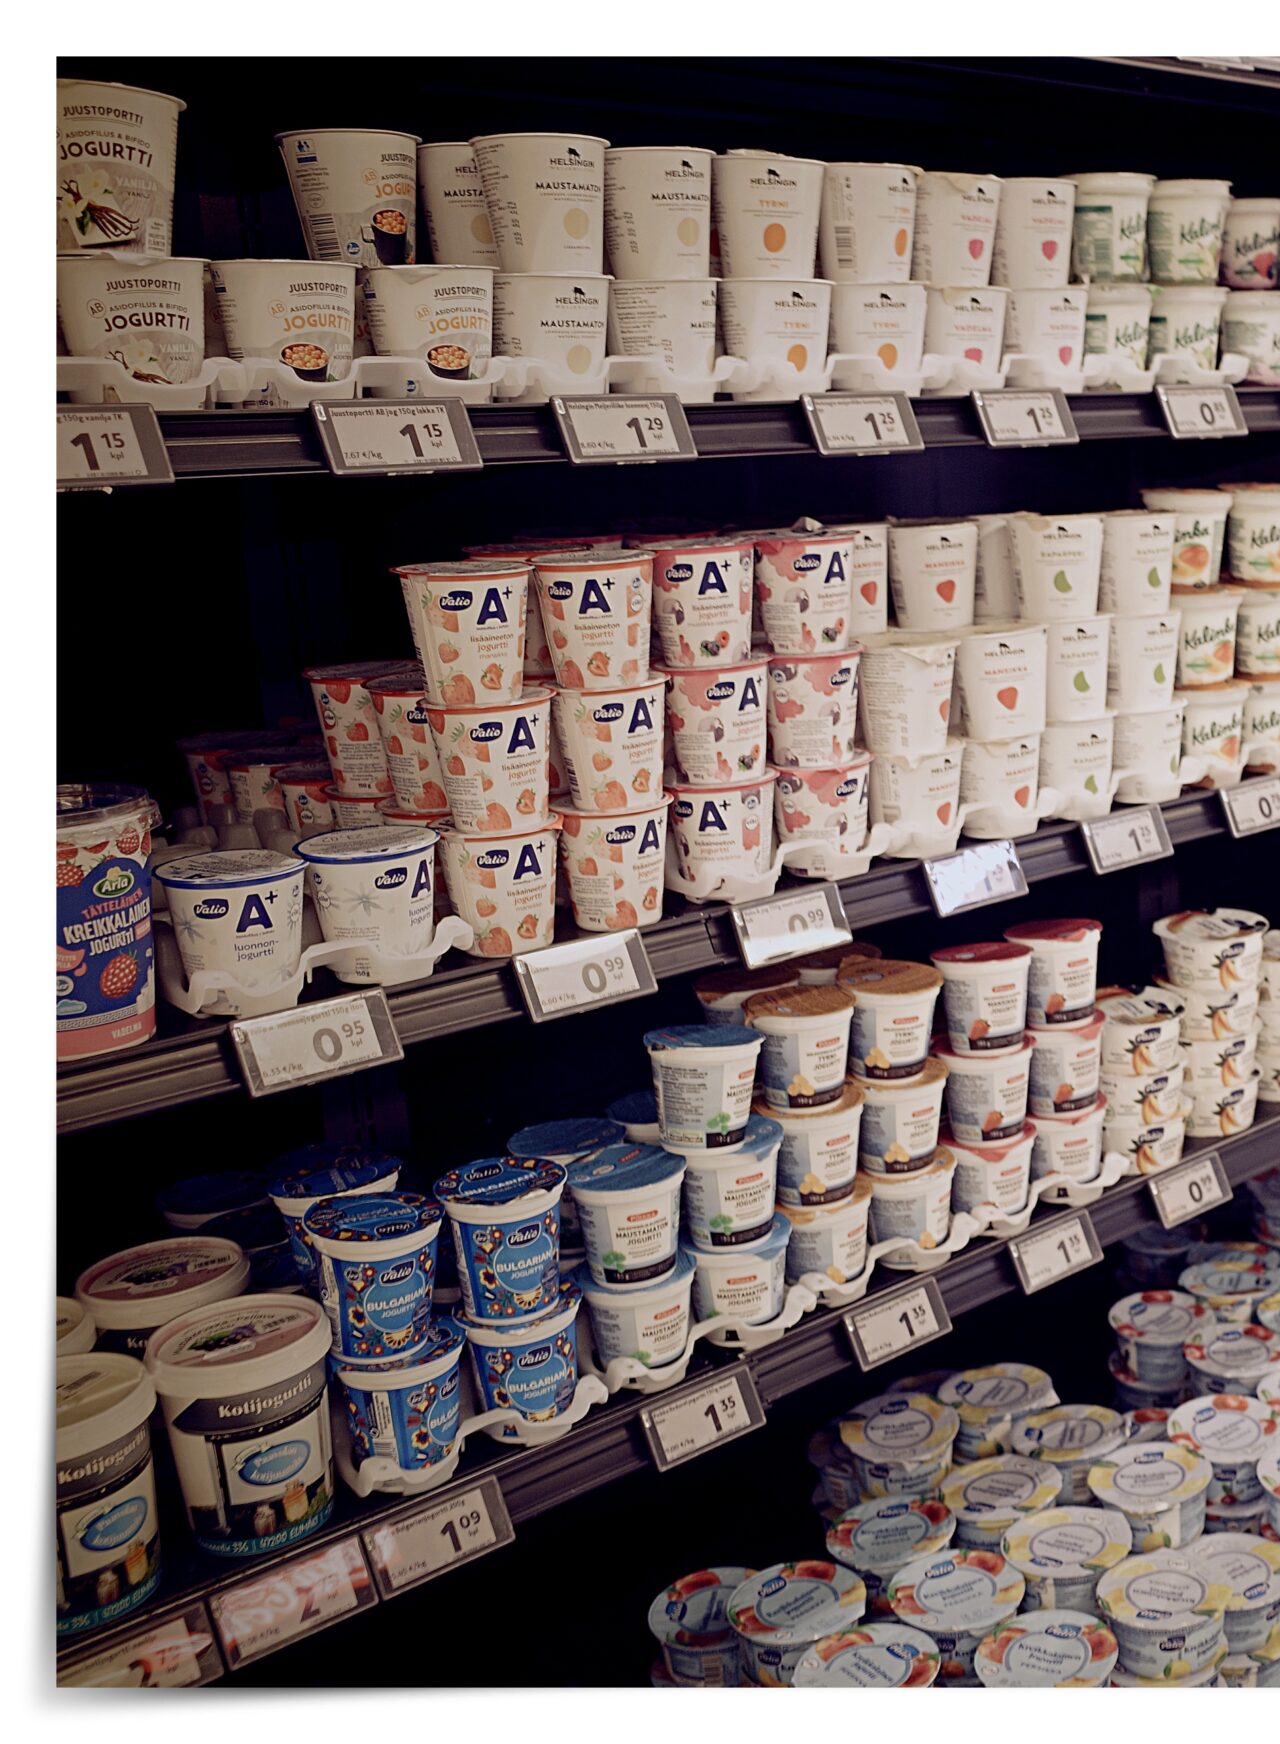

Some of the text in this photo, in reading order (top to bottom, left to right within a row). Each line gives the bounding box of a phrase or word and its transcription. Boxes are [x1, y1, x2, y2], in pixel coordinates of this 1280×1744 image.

[62, 105, 144, 125] JUUSTOPORTTI
[65, 130, 114, 139] ASIDOFILUS
[60, 140, 153, 168] JOGURTTI
[549, 157, 596, 169] HELSINGIN
[105, 279, 182, 292] JUUSTOPORTTI
[288, 282, 348, 295] JUUSTOPORTTI
[91, 302, 103, 315] AB
[109, 302, 157, 312] ASIDOFILUS
[555, 297, 599, 306] HELSINGIN
[104, 311, 190, 332] JOGURTTI
[283, 314, 351, 332] JOGURTTI
[85, 413, 112, 425] vanilja
[331, 409, 374, 418] Juustoportti
[1027, 408, 1042, 433] 1
[1200, 403, 1215, 425] 0
[626, 417, 664, 449] 1 29
[865, 413, 895, 440] 1 25
[399, 423, 442, 457] 1 15
[431, 440, 443, 449] kpl
[70, 432, 126, 471] 1 15
[110, 451, 125, 461] kpl
[698, 560, 732, 595] A+
[550, 586, 573, 597] Valio
[578, 577, 615, 615] A+
[441, 595, 472, 607] Valio
[476, 586, 514, 625] A+
[574, 623, 621, 631] lisäaineeton
[581, 630, 615, 641] jogurtti
[470, 634, 514, 643] lisäaineeton
[477, 641, 509, 653] jogurtti
[594, 708, 623, 719] Valio
[627, 695, 657, 735] A+
[472, 727, 502, 739] Valio
[507, 713, 540, 754] A+
[508, 767, 538, 781] jogurtti
[698, 800, 731, 832] A+
[1259, 797, 1272, 819] 0
[607, 830, 635, 842] Valio
[638, 817, 665, 854] A+
[1128, 828, 1142, 852] 1
[478, 855, 508, 867] Valio
[513, 840, 547, 880] A+
[101, 876, 130, 894] Arla
[376, 873, 407, 886] Valio
[513, 892, 543, 906] jogurtti
[195, 903, 227, 915] Valio
[236, 890, 279, 933] A+
[807, 909, 824, 924] 99
[89, 930, 135, 957] JOGURTTI
[234, 938, 280, 952] luonnon-
[237, 948, 275, 962] jogurtti
[580, 963, 608, 994] 0
[604, 956, 624, 973] 99
[313, 1020, 365, 1063] 0 95
[351, 1038, 363, 1048] kpl
[468, 1165, 501, 1180] Valio
[1190, 1181, 1203, 1202] 0
[509, 1227, 539, 1244] Valio
[616, 1222, 669, 1239] MAUSTAMATON
[627, 1234, 662, 1246] JOGURTTI
[1057, 1239, 1072, 1264] 1
[495, 1250, 551, 1272] BULGARIAN
[382, 1266, 412, 1284] Valio
[510, 1264, 544, 1280] JOGURTTI
[367, 1286, 424, 1311] BULGARIAN
[717, 1287, 769, 1300] MAUSTAMATON
[380, 1301, 416, 1319] JOGURTTI
[899, 1311, 915, 1338] 1
[913, 1305, 927, 1320] 35
[520, 1350, 550, 1367] Valio
[508, 1368, 567, 1394] BULGARIAN
[218, 1375, 313, 1420] Kotijogurtti
[523, 1384, 557, 1399] JOGURTTI
[704, 1403, 723, 1433] 1
[720, 1395, 737, 1412] 35
[57, 1426, 147, 1486] Kotijogurtti
[441, 1520, 462, 1553] 1
[459, 1510, 481, 1529] 09
[926, 1563, 955, 1578] Valio
[759, 1579, 786, 1598] Valio
